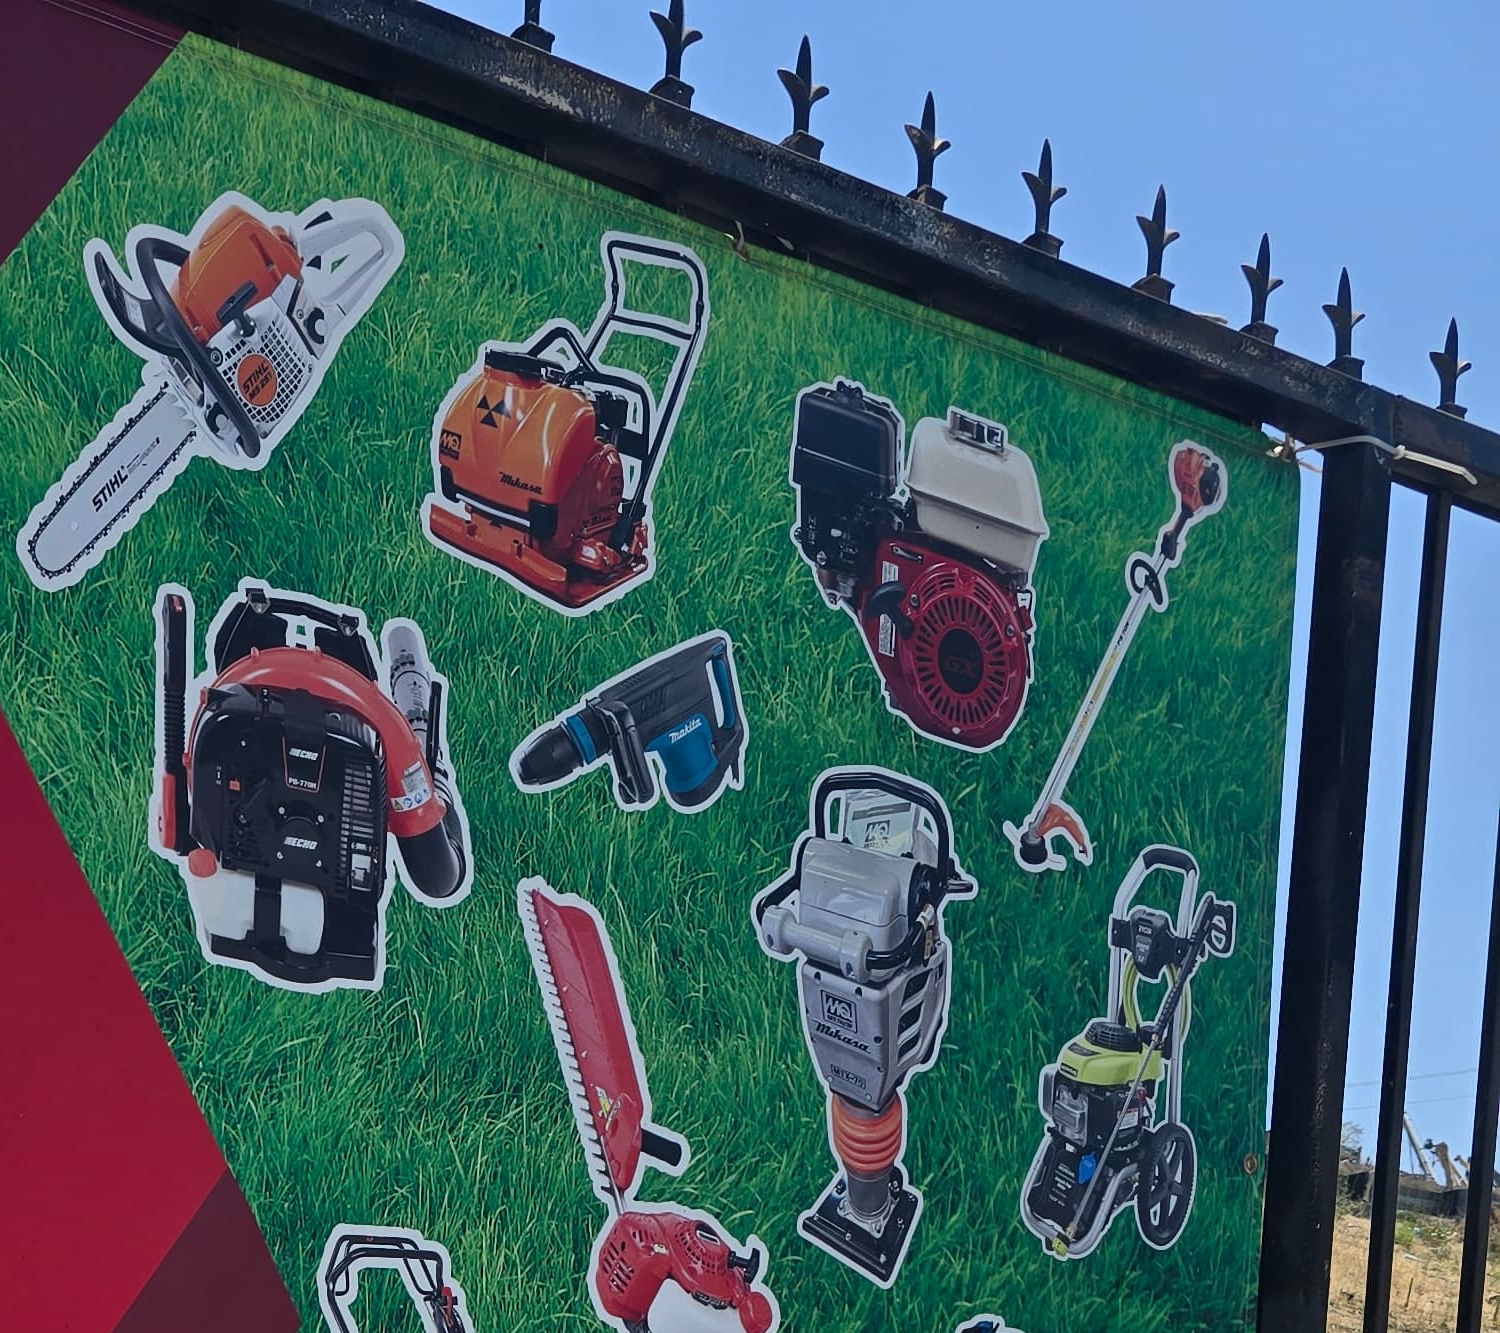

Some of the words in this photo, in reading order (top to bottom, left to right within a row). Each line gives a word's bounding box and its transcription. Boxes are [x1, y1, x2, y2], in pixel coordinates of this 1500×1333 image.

[243, 362, 269, 394] STIHL
[92, 469, 129, 512] STIHL
[500, 471, 543, 495] Mikasa
[296, 748, 319, 760] ECHO
[290, 837, 318, 850] ECHO
[813, 1019, 871, 1054] Mikasa
